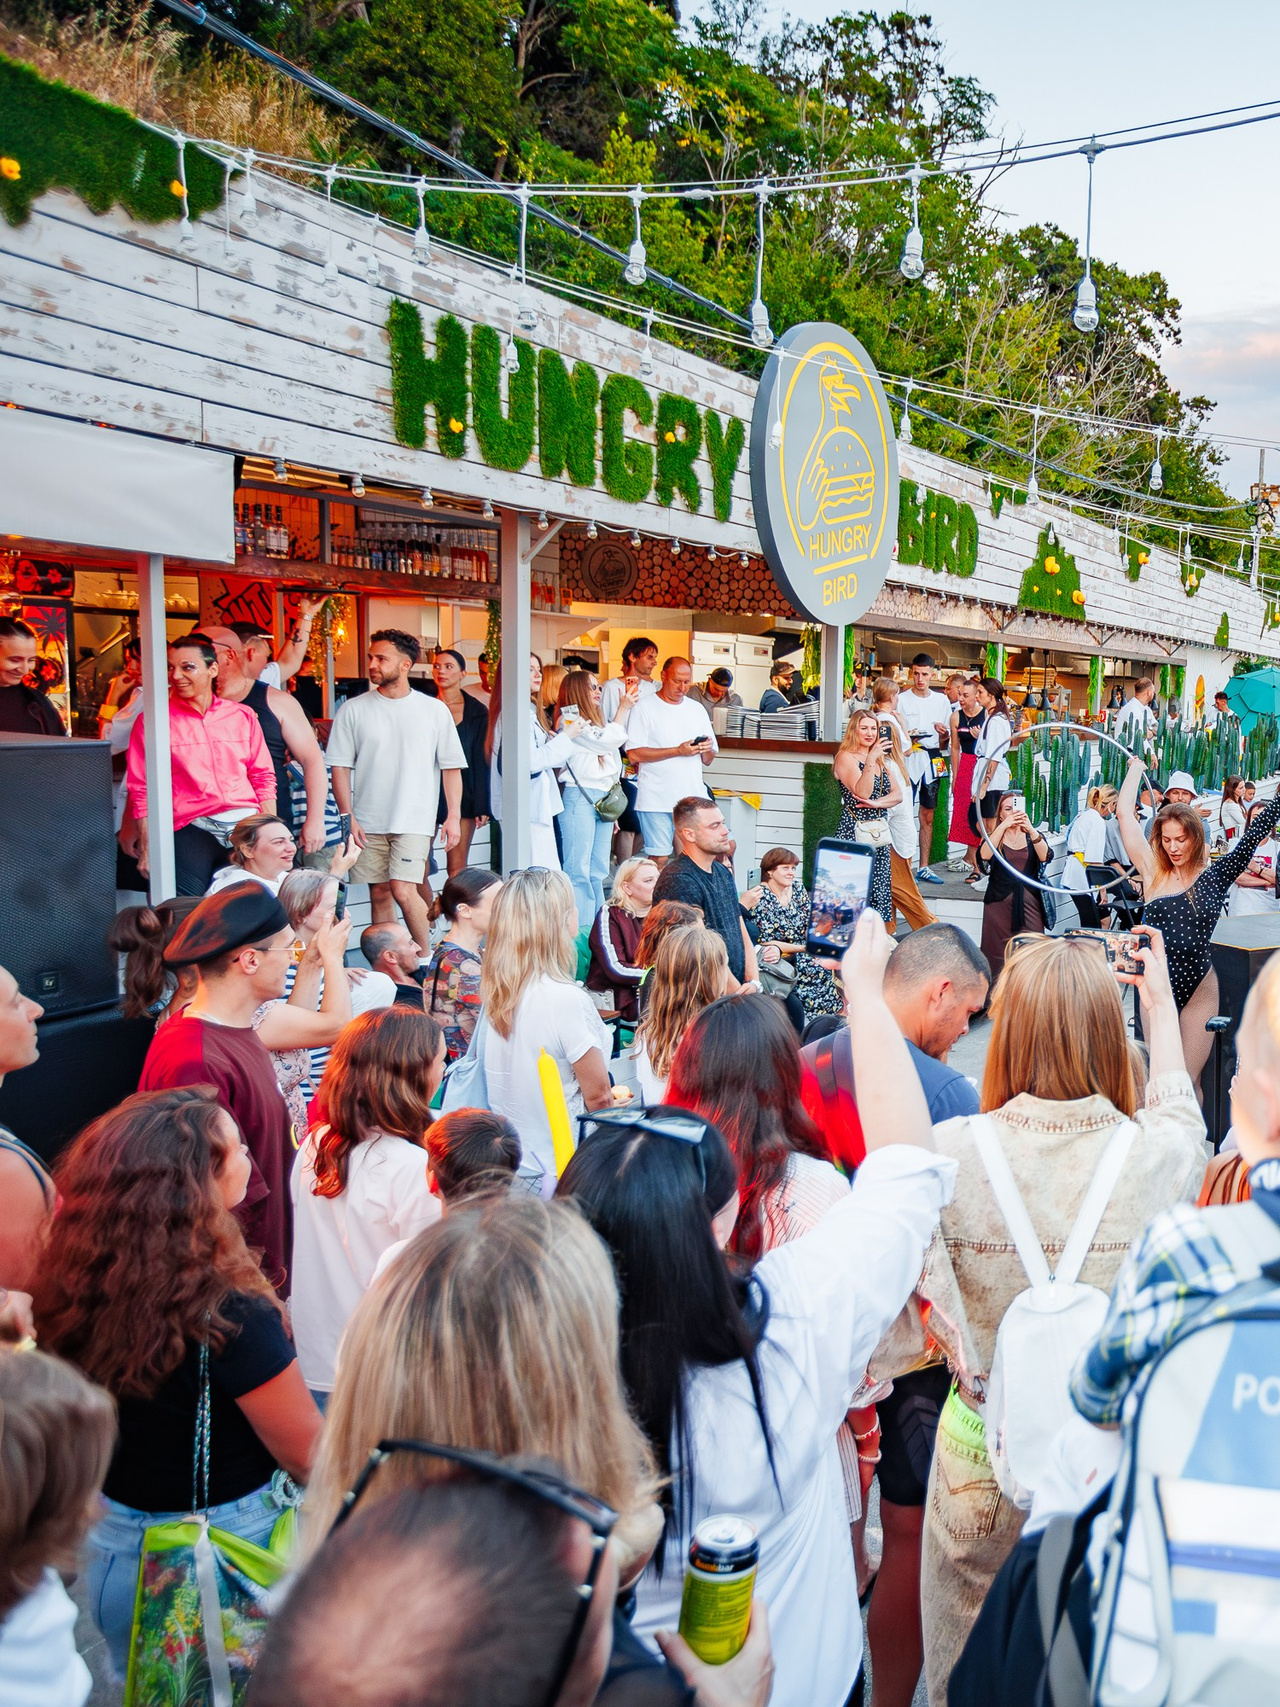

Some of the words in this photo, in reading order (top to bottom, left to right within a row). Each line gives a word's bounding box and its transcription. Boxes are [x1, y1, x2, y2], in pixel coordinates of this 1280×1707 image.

[387, 297, 746, 523] HUNGRY
[897, 478, 979, 579] BIRD
[809, 523, 872, 561] HUNGRY
[822, 573, 858, 606] BIRD
